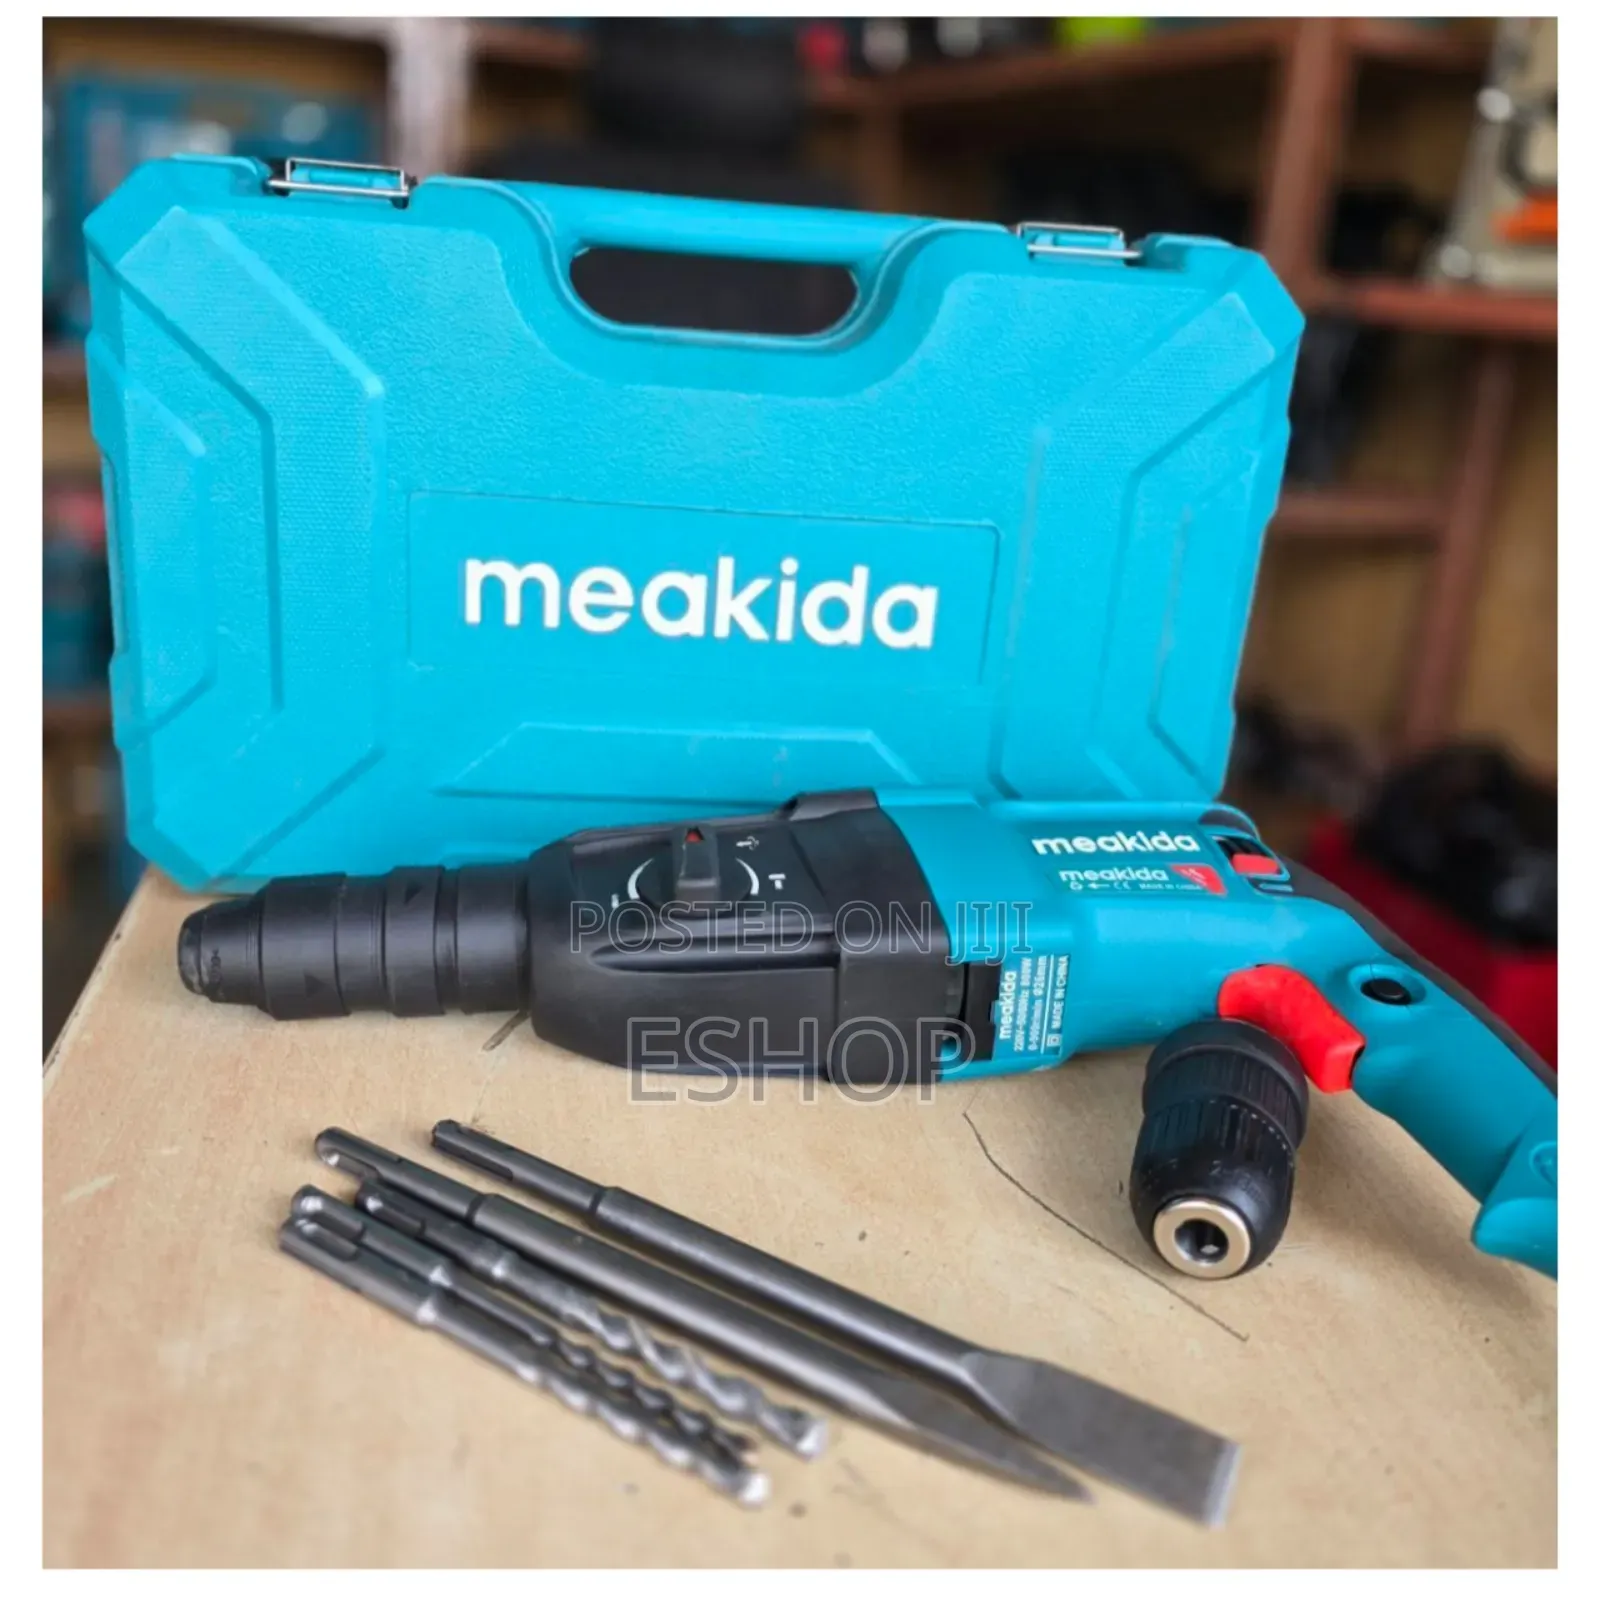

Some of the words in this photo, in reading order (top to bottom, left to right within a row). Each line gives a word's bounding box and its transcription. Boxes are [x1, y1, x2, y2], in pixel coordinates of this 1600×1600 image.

[465, 556, 938, 649] meakida
[1031, 830, 1200, 855] meakida
[1059, 867, 1169, 882] meakida
[1056, 955, 1069, 987] CHINA
[999, 971, 1017, 1039] meakida
[1055, 988, 1066, 999] IN
[1051, 1000, 1064, 1029] MADE
